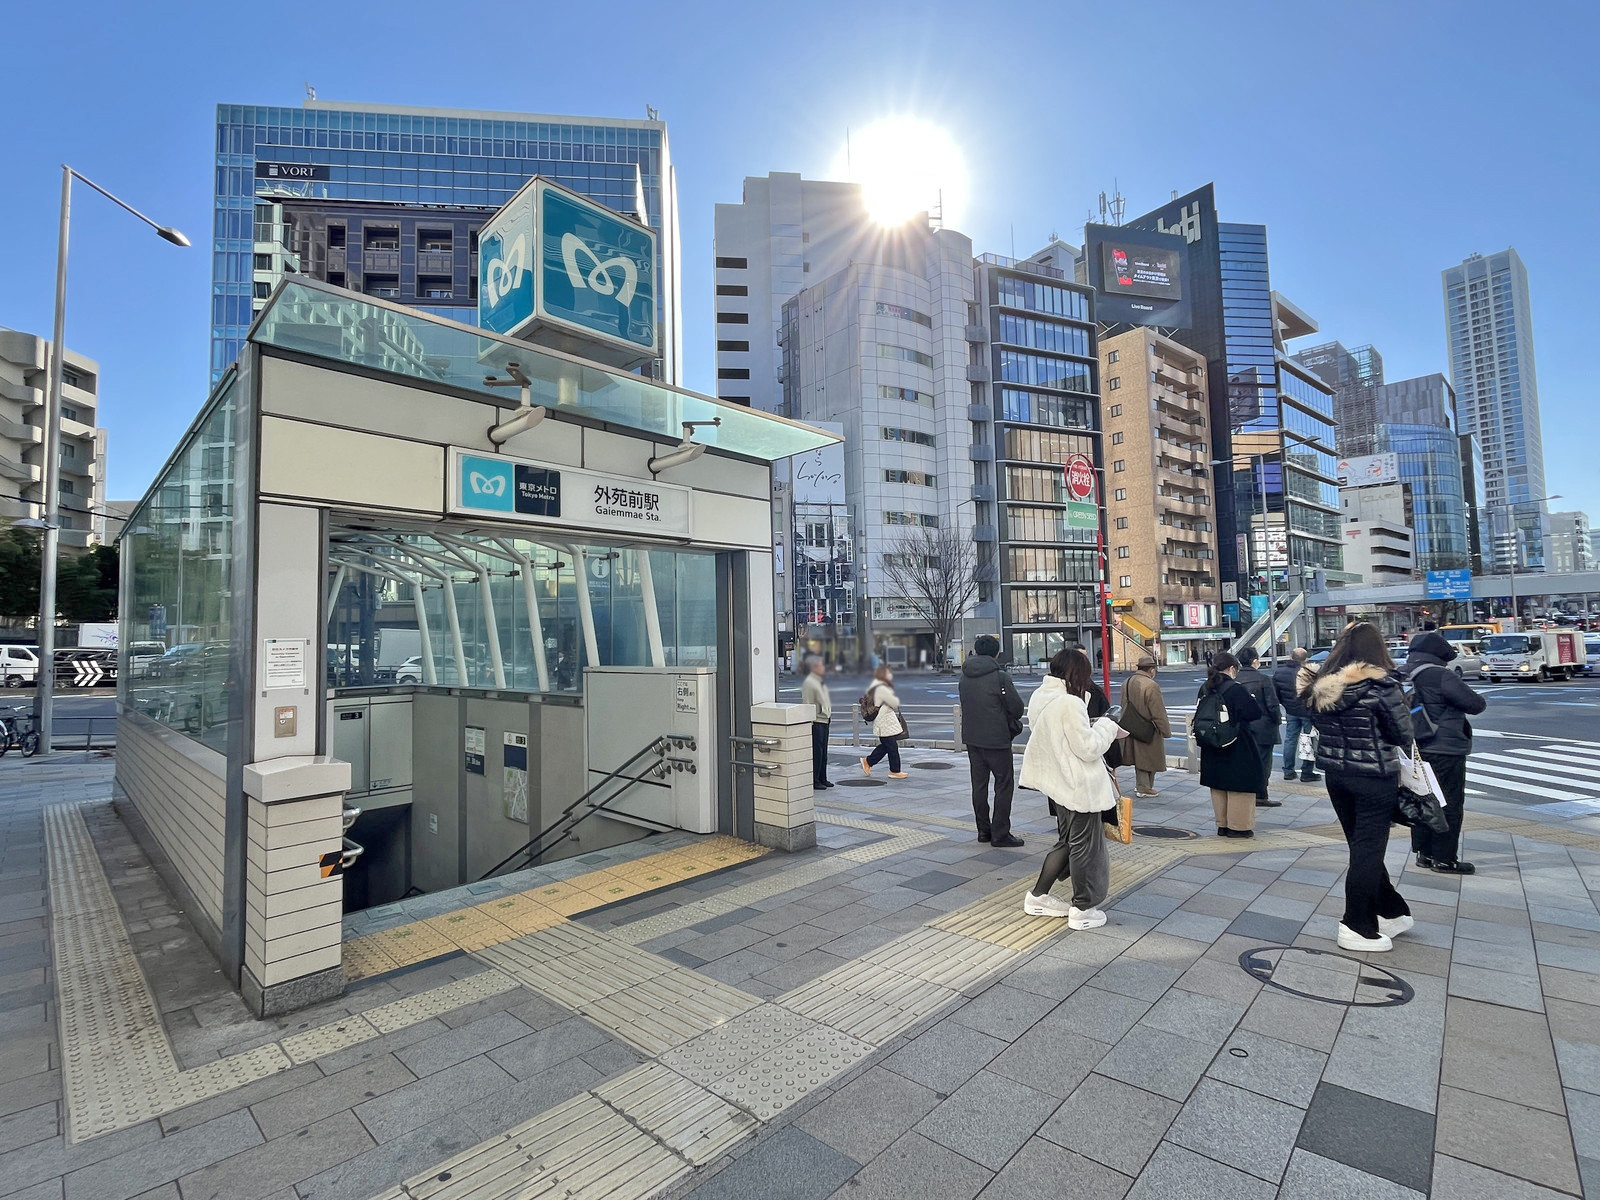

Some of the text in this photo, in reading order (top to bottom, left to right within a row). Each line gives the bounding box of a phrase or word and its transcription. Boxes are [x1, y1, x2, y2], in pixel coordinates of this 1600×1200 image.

[282, 166, 315, 177] VORT
[1072, 471, 1090, 487] 消火栓
[519, 482, 557, 495] 東京メトロ
[521, 490, 555, 501] Tokyo Metro
[594, 485, 659, 512] 外苑前駅
[595, 505, 661, 522] Gaiemmae Sta.
